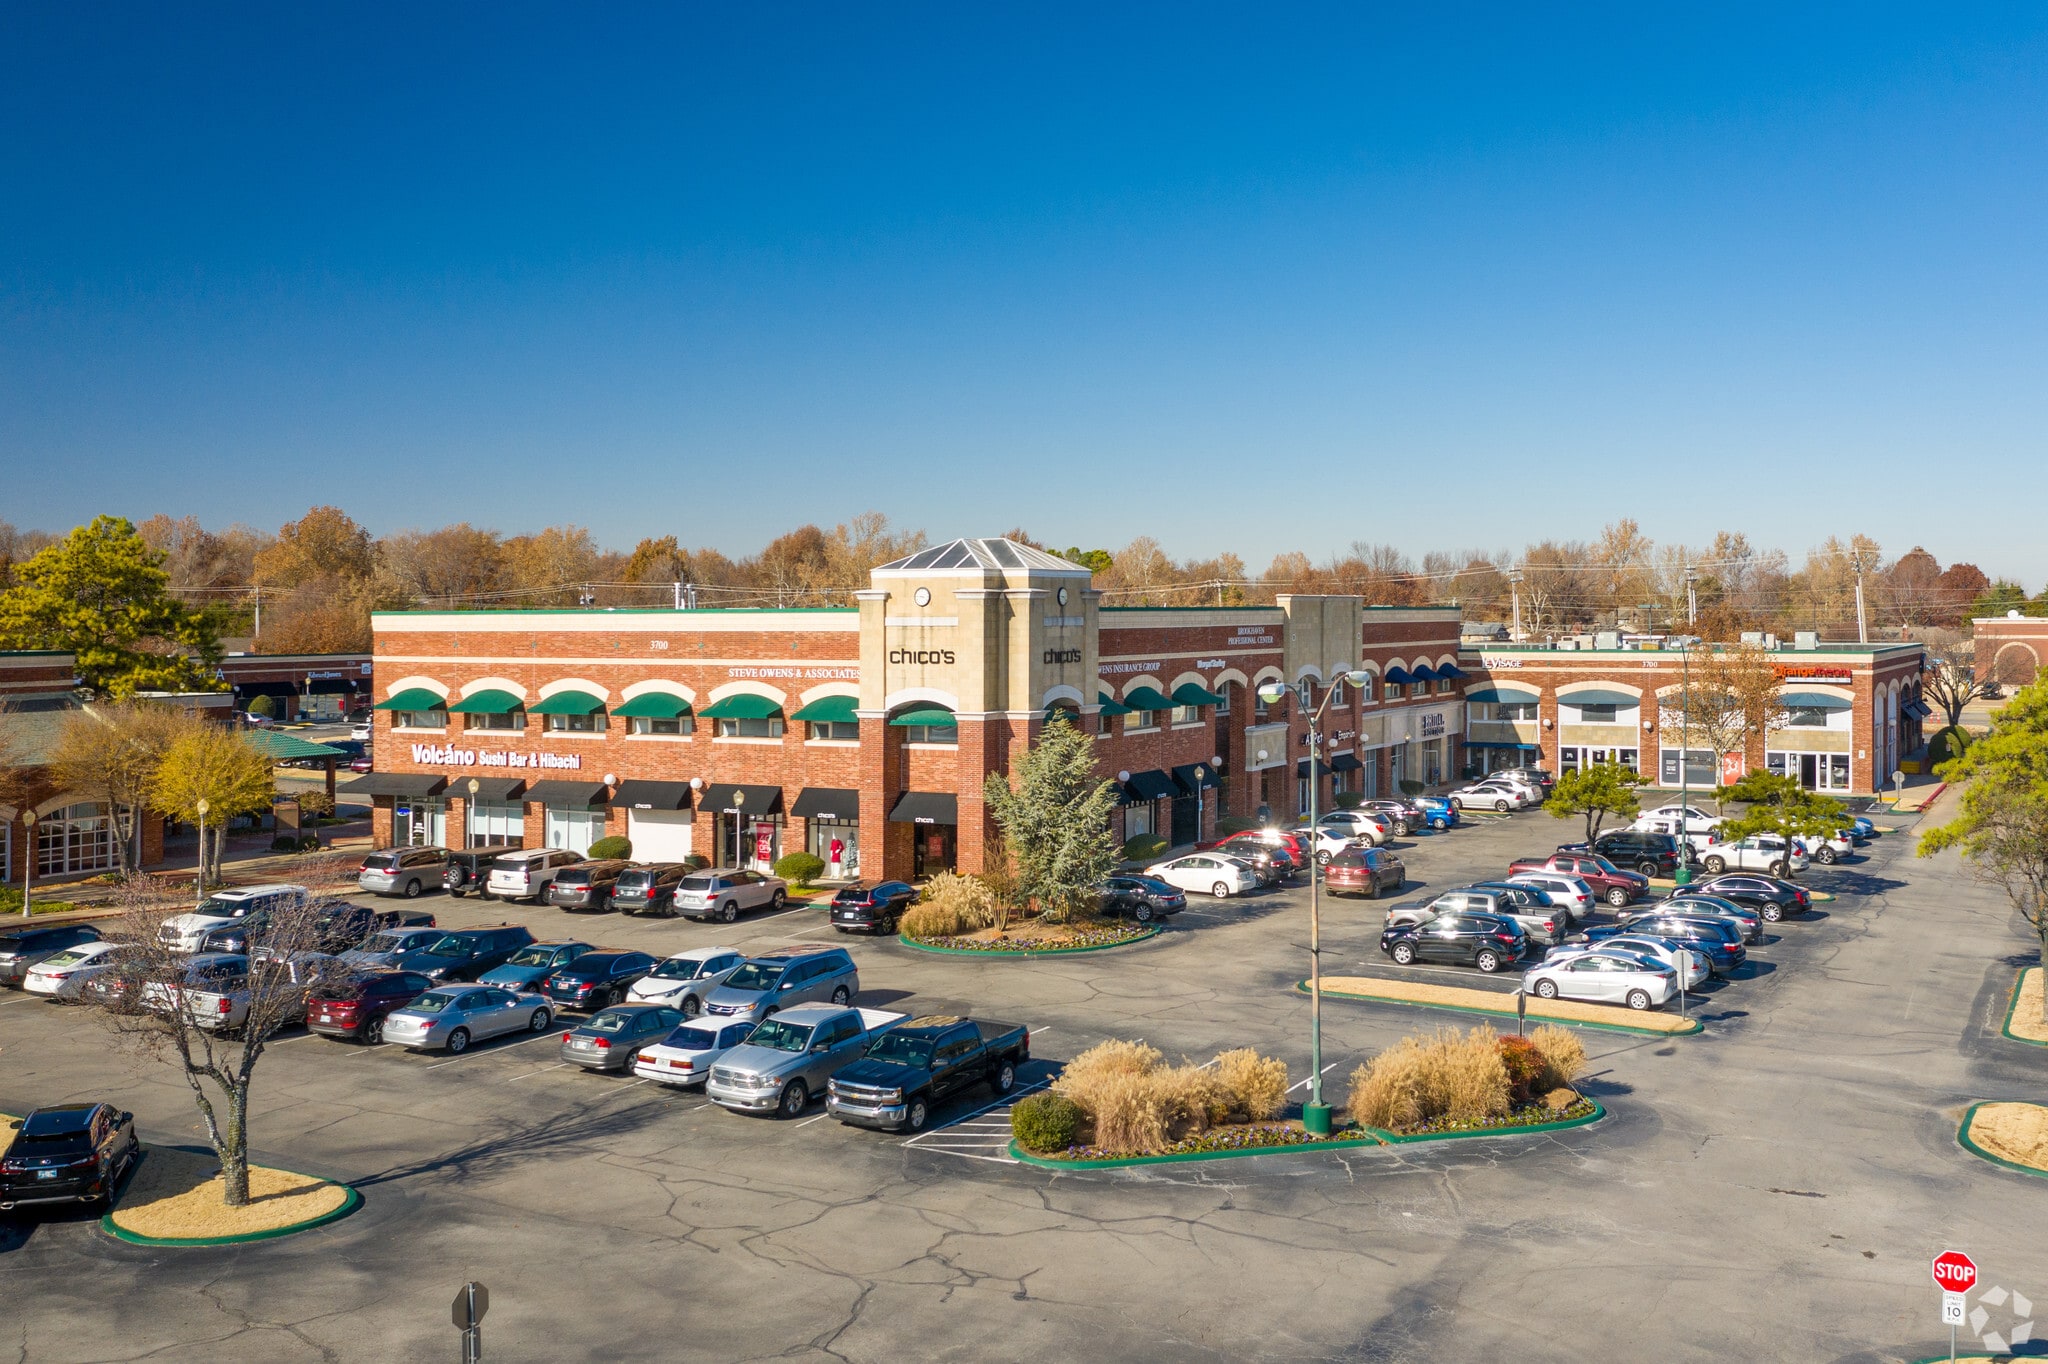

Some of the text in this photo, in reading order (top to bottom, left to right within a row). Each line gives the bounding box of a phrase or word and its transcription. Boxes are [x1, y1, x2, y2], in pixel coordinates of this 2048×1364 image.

[650, 641, 668, 650] 3700
[889, 648, 955, 665] chico's
[1043, 647, 1082, 665] chico's
[729, 668, 861, 679] STEVE OWENS & ASSOCIATES
[479, 751, 508, 767] Sushi
[508, 752, 528, 767] Bar
[530, 753, 539, 768] &
[540, 752, 582, 769] Hibachi
[1936, 1262, 1974, 1281] STOP
[1947, 1306, 1961, 1317] 10
